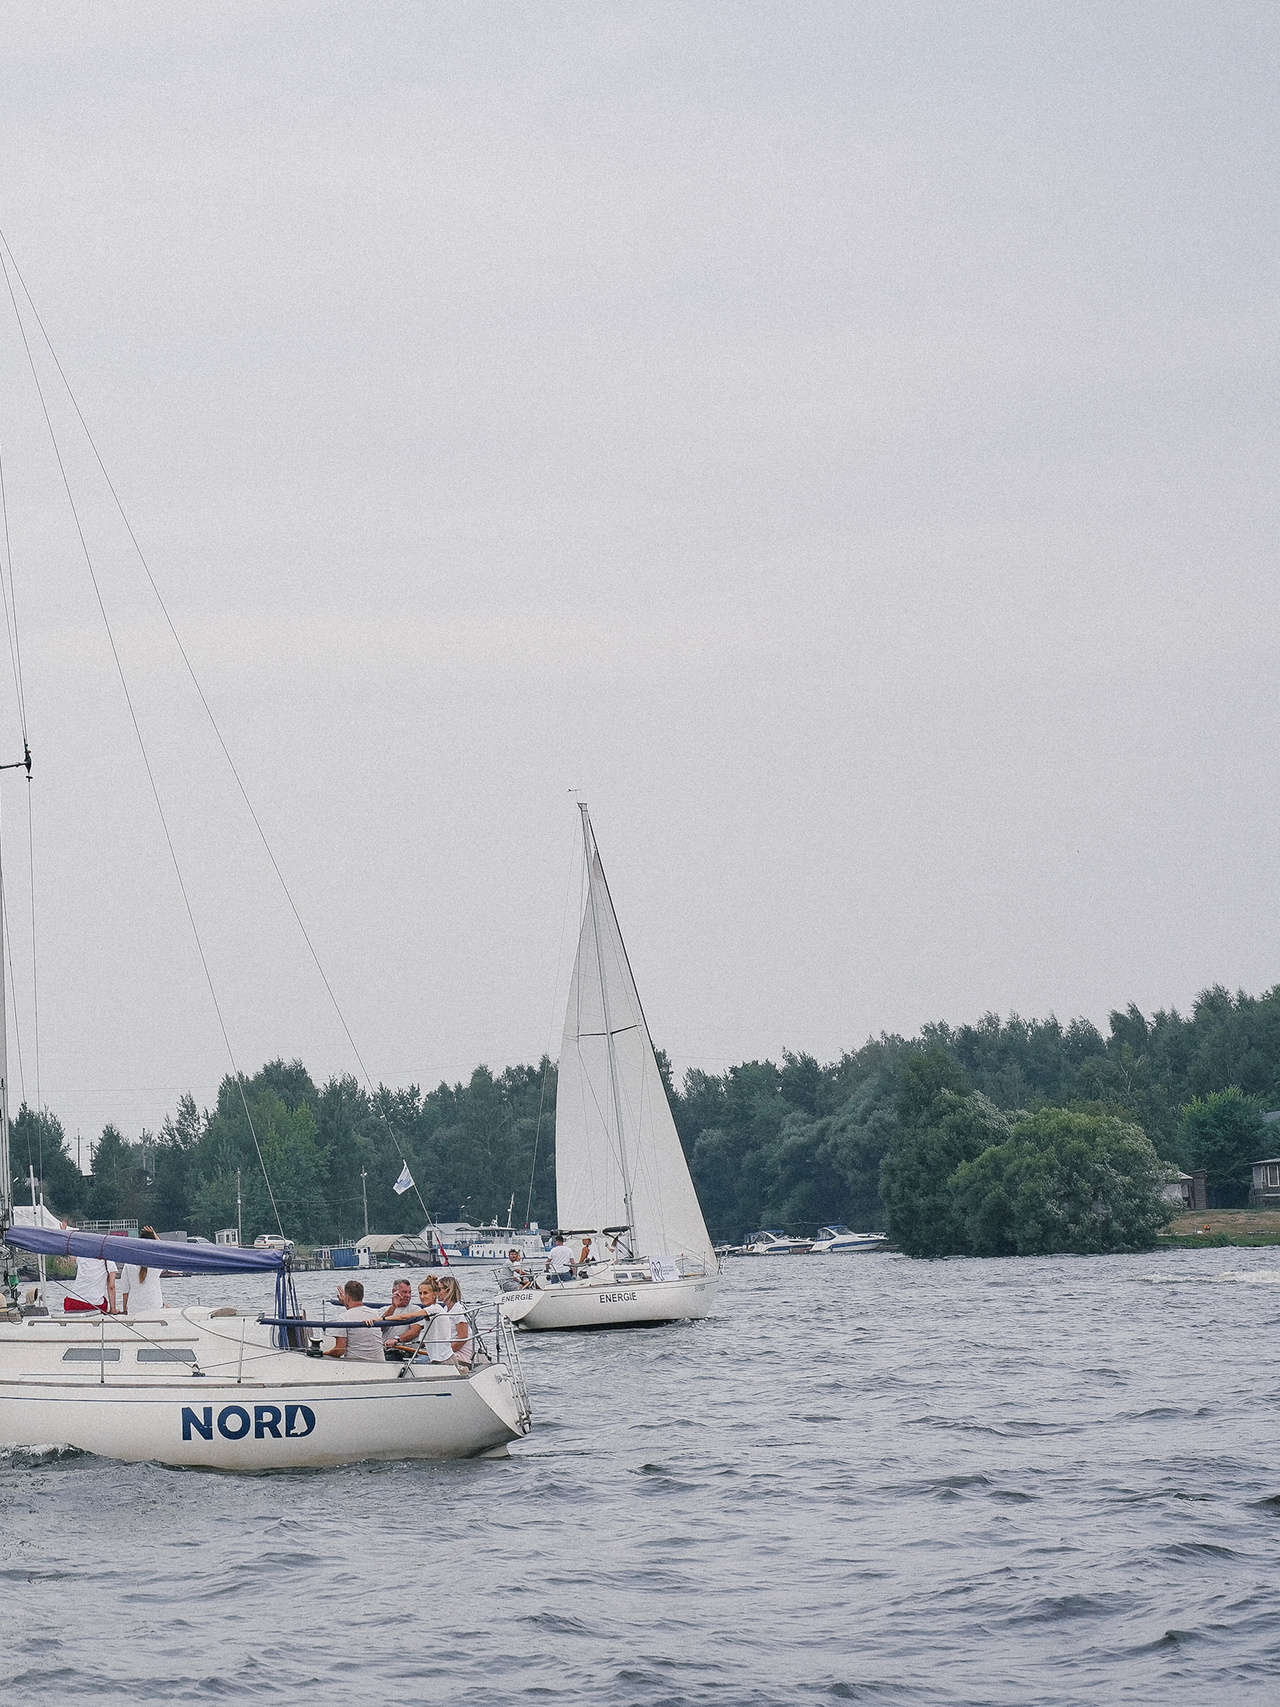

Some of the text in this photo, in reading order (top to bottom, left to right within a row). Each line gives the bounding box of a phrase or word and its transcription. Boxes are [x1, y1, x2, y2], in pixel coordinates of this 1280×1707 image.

[501, 1293, 533, 1303] ENERGIE
[599, 1292, 637, 1304] ENERGIE
[181, 1404, 316, 1441] NORD
